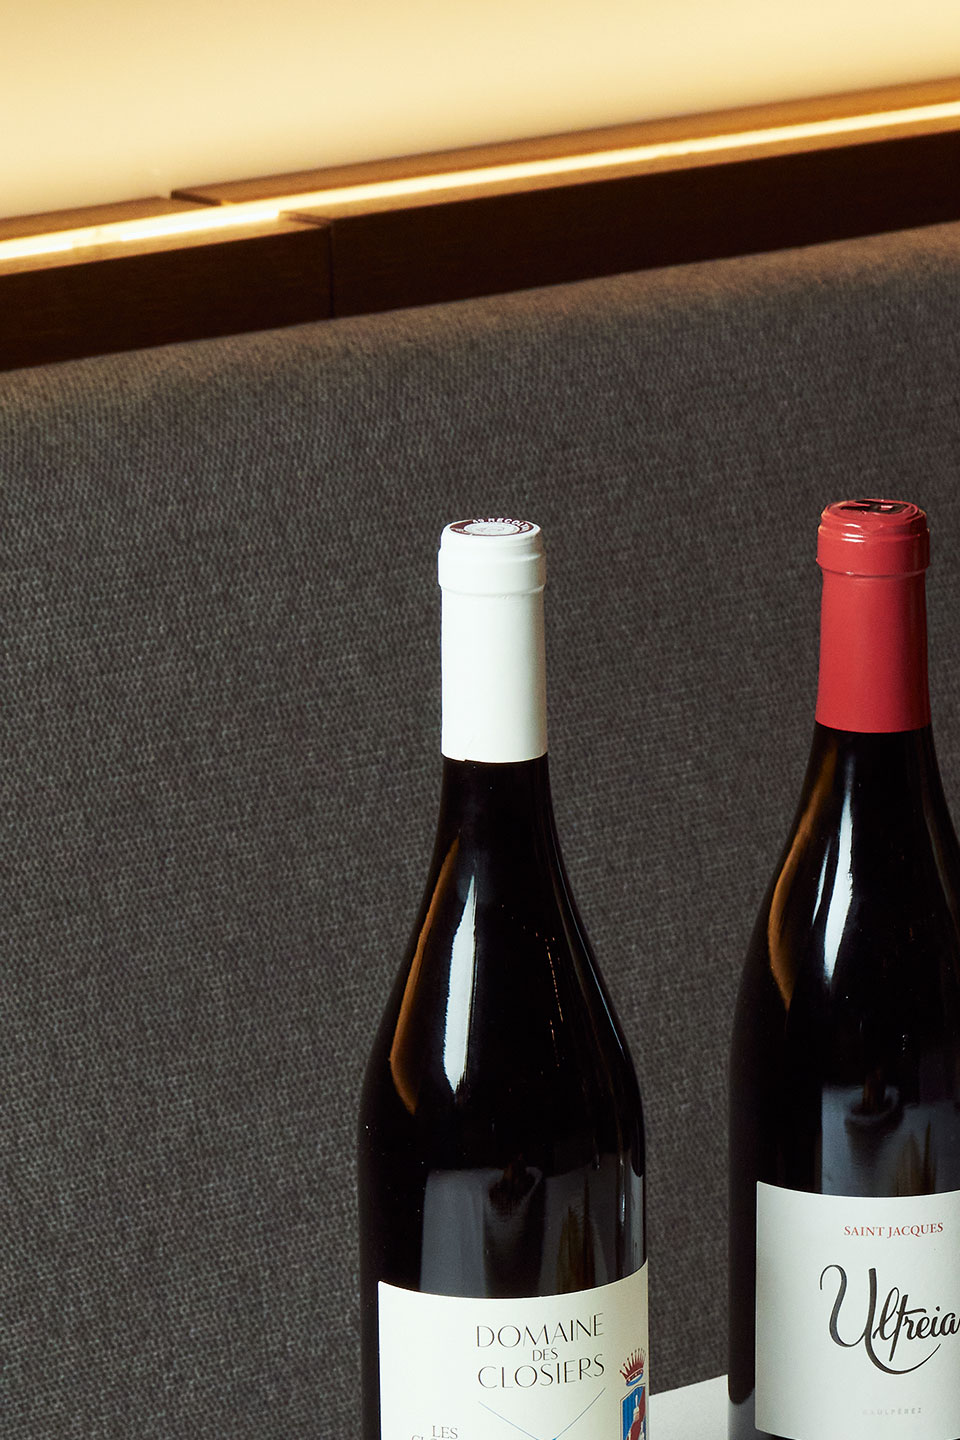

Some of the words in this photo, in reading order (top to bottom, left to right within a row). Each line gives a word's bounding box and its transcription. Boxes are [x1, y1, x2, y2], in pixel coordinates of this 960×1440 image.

[843, 1225, 885, 1237] SAINT
[887, 1222, 944, 1239] JACQUES
[476, 1312, 605, 1349] DOMAINE
[532, 1347, 559, 1362] DES
[477, 1353, 605, 1389] CLOSIERS
[432, 1425, 458, 1440] LES
